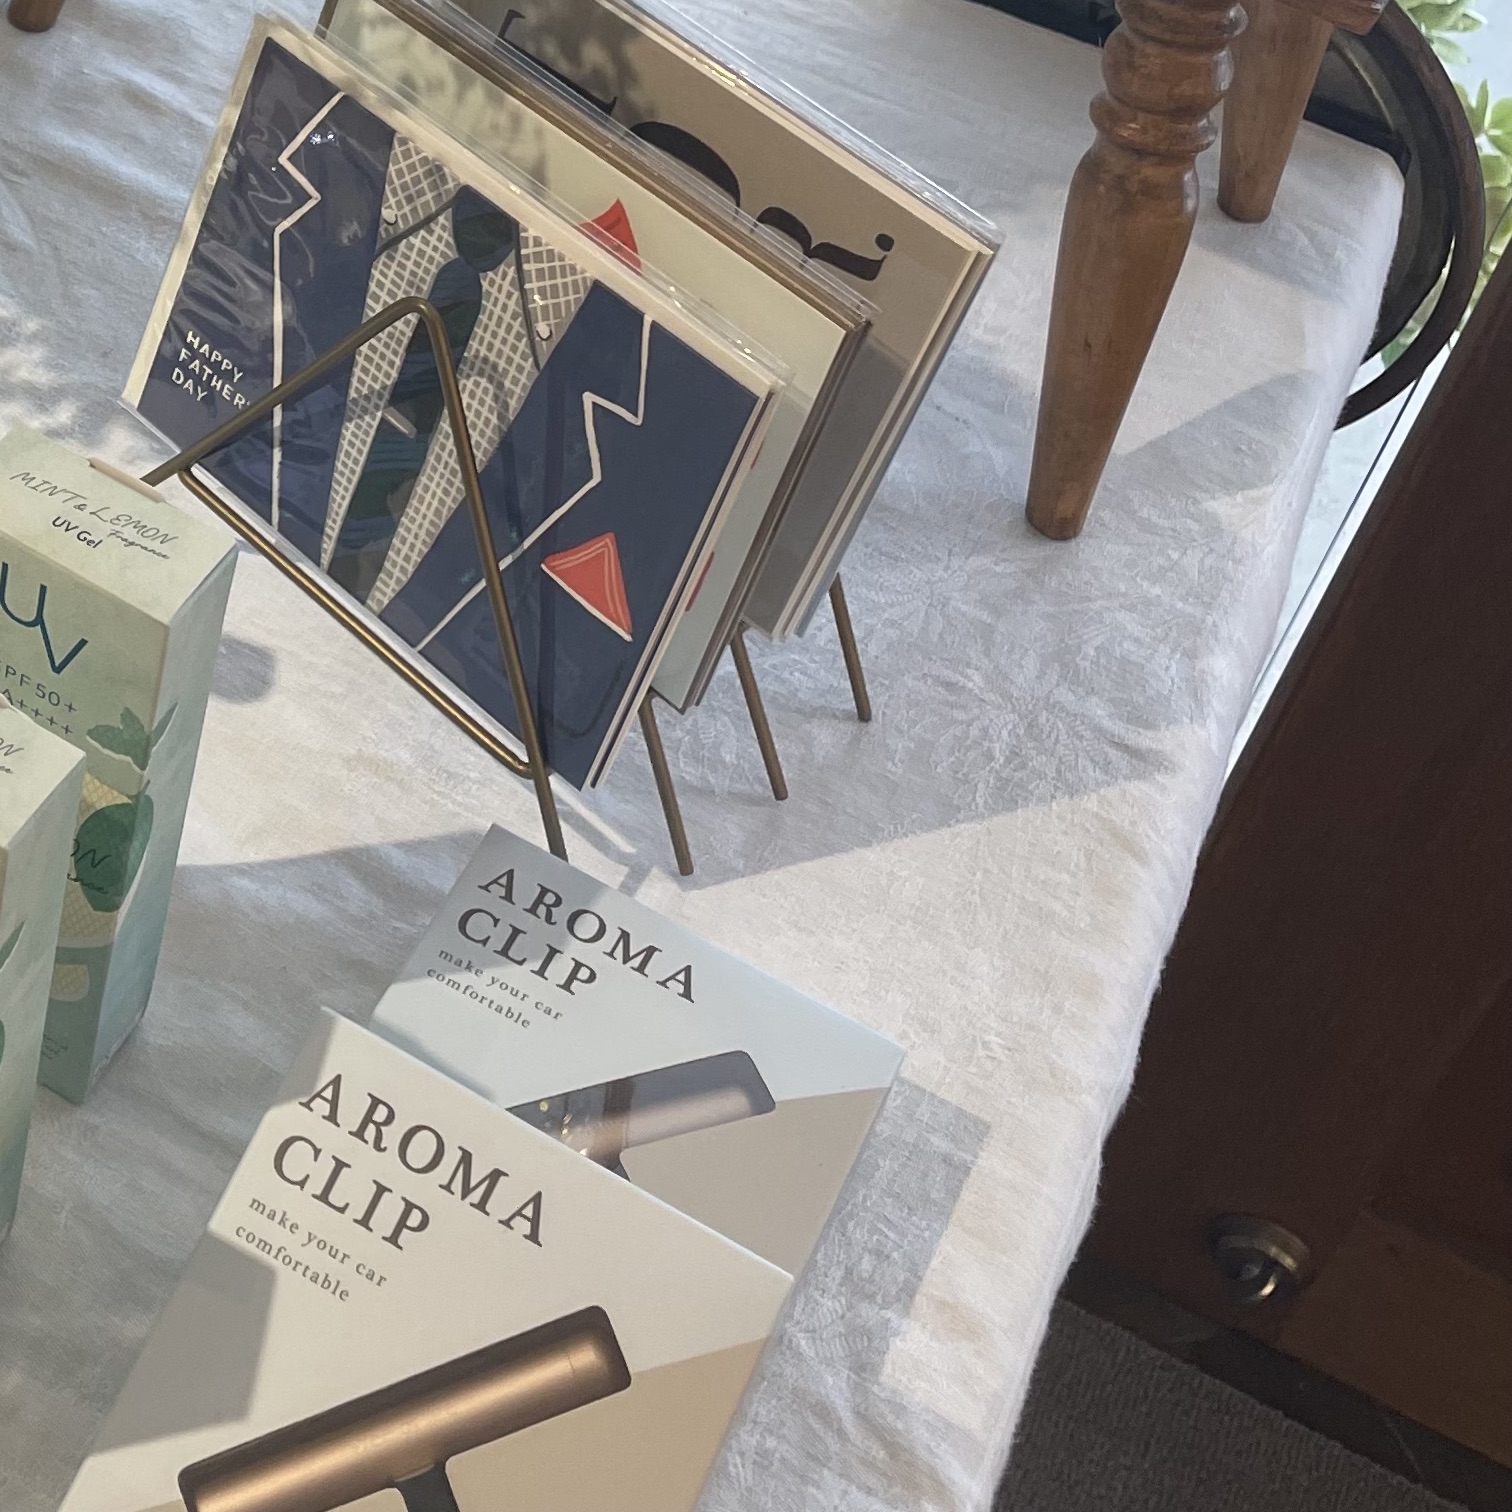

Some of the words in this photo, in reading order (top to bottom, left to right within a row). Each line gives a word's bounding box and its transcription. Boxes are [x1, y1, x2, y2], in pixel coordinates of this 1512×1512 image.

[171, 367, 208, 402] DAY
[178, 348, 251, 410] FATHER'
[186, 330, 244, 383] HAPPY
[51, 516, 80, 534] UV
[76, 529, 104, 550] Gel
[107, 529, 171, 560] Fragrance
[457, 908, 598, 996] CLIP
[477, 868, 696, 1004] AROMA
[426, 966, 532, 1030] comfortable
[438, 947, 486, 980] make
[485, 971, 532, 1003] your
[534, 997, 565, 1022] car
[272, 1134, 431, 1252] CLIP
[299, 1073, 545, 1249] AROMA
[234, 1222, 352, 1304] comfortable
[248, 1195, 301, 1238] make
[300, 1226, 352, 1268] your
[354, 1256, 389, 1289] car
